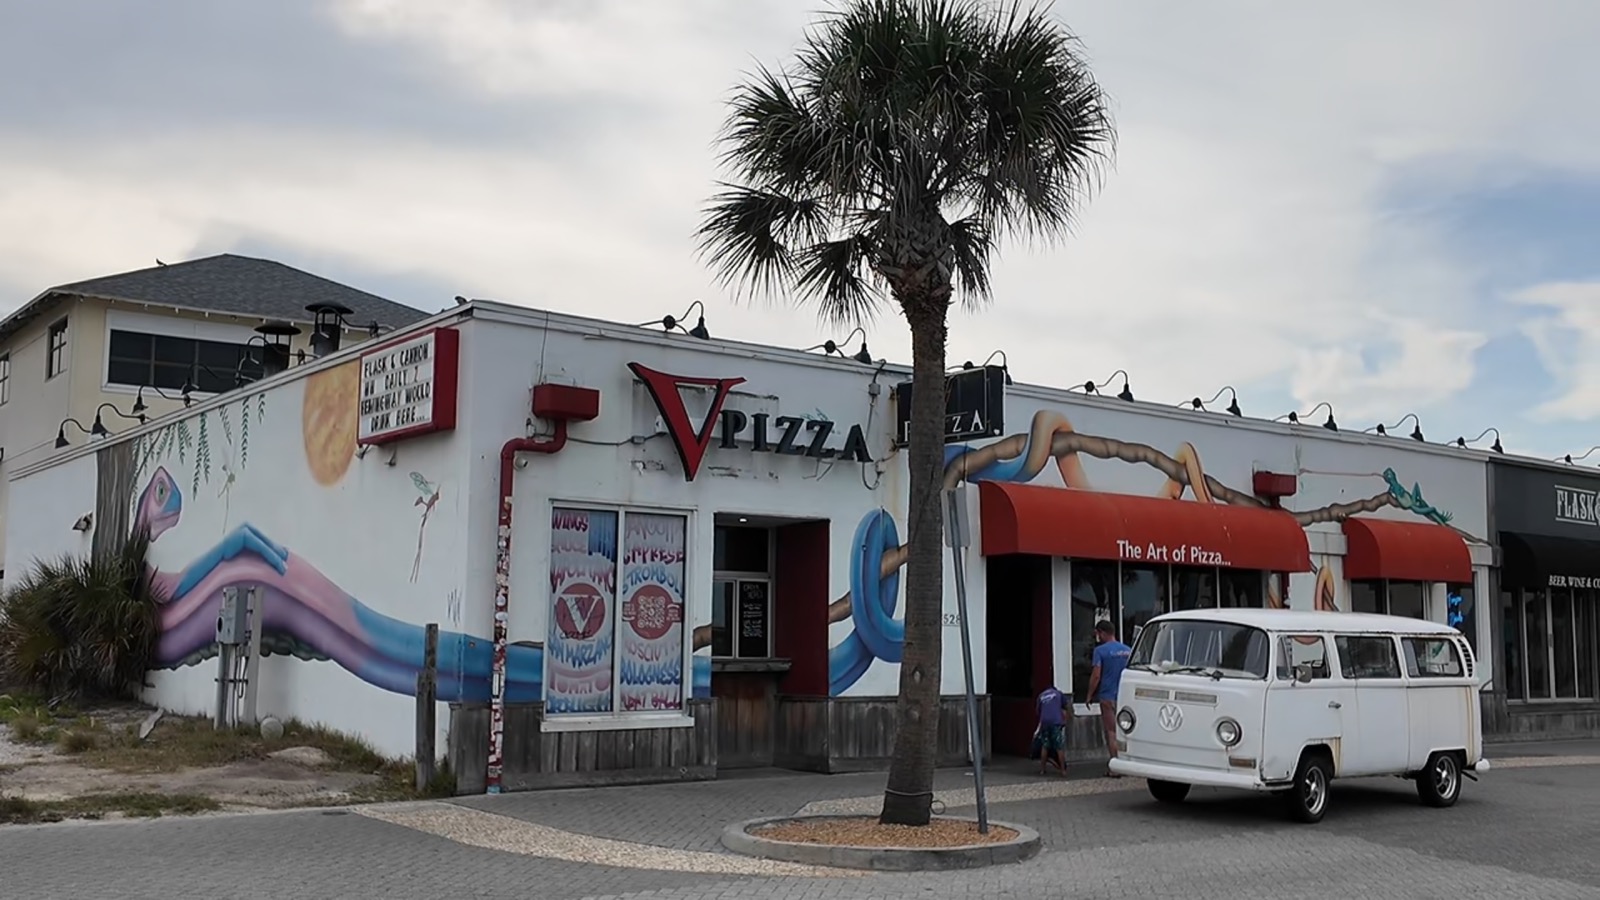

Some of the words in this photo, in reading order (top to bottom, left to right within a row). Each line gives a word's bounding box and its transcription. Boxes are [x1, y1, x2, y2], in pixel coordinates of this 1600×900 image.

[718, 408, 874, 463] PIZZA
[904, 409, 984, 442] PZA
[1556, 489, 1596, 522] FLASK
[1117, 539, 1141, 559] The
[1146, 542, 1168, 561] Art
[1172, 544, 1186, 562] of
